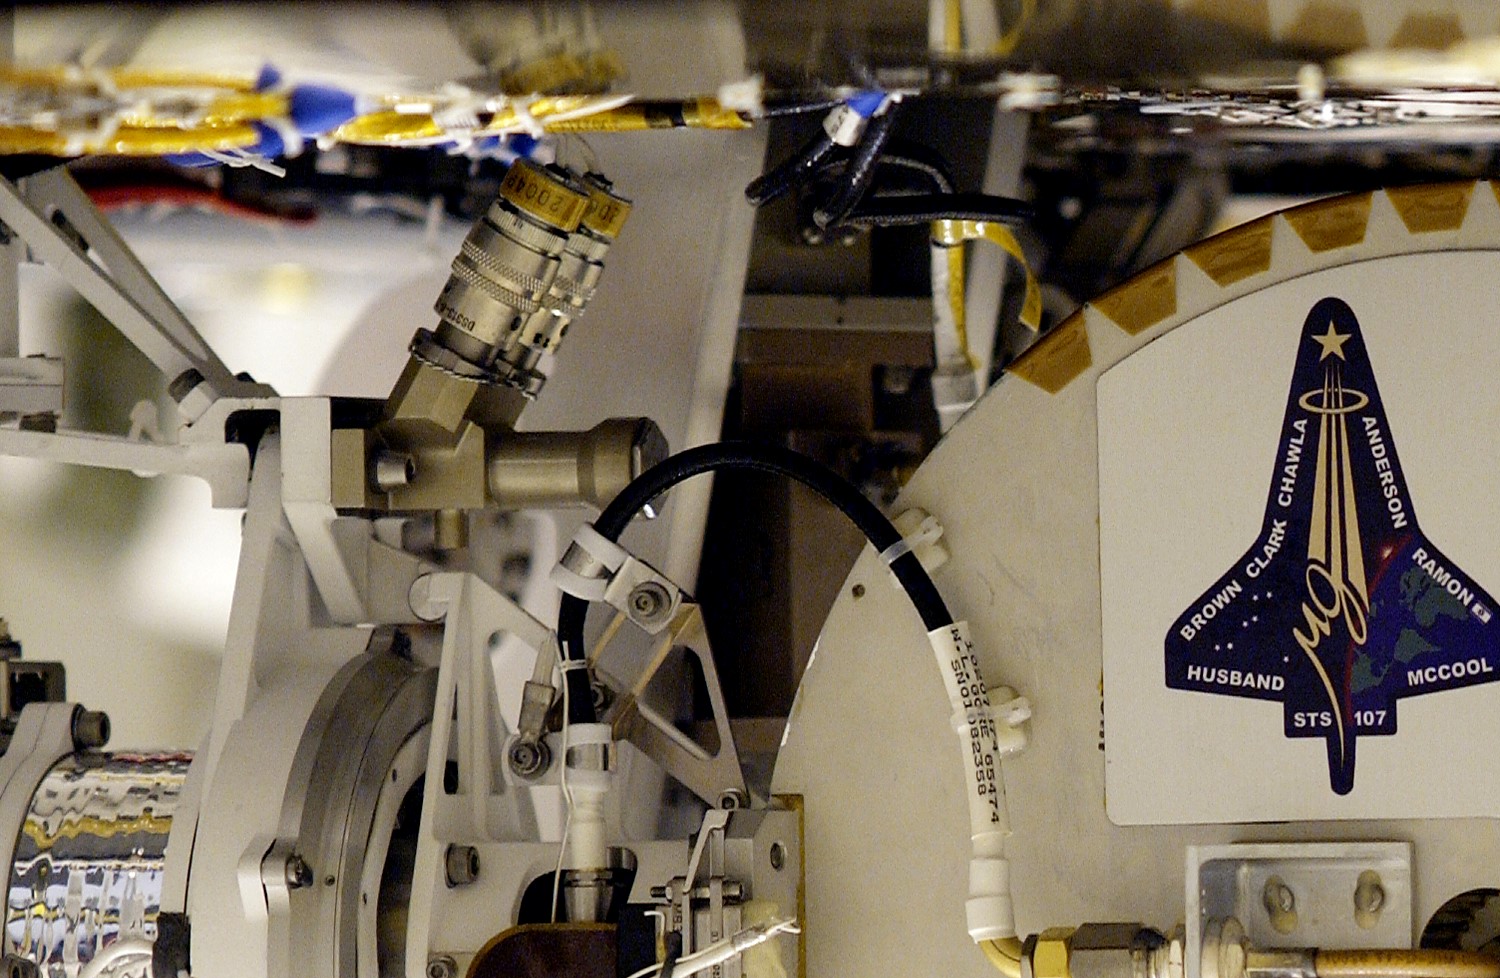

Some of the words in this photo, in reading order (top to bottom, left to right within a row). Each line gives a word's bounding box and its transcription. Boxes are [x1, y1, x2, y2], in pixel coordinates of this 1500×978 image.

[1180, 580, 1243, 642] BROWN
[1245, 518, 1288, 579] CLARK
[1277, 417, 1308, 508] CHAWLA
[1361, 415, 1408, 529] ANDERSON
[1412, 547, 1475, 607] RAMON
[1186, 664, 1286, 692] HUSBAND
[1406, 656, 1494, 687] MCCOOL
[1293, 711, 1333, 728] STS
[1354, 710, 1387, 727] 107
[984, 753, 1000, 824] 65474
